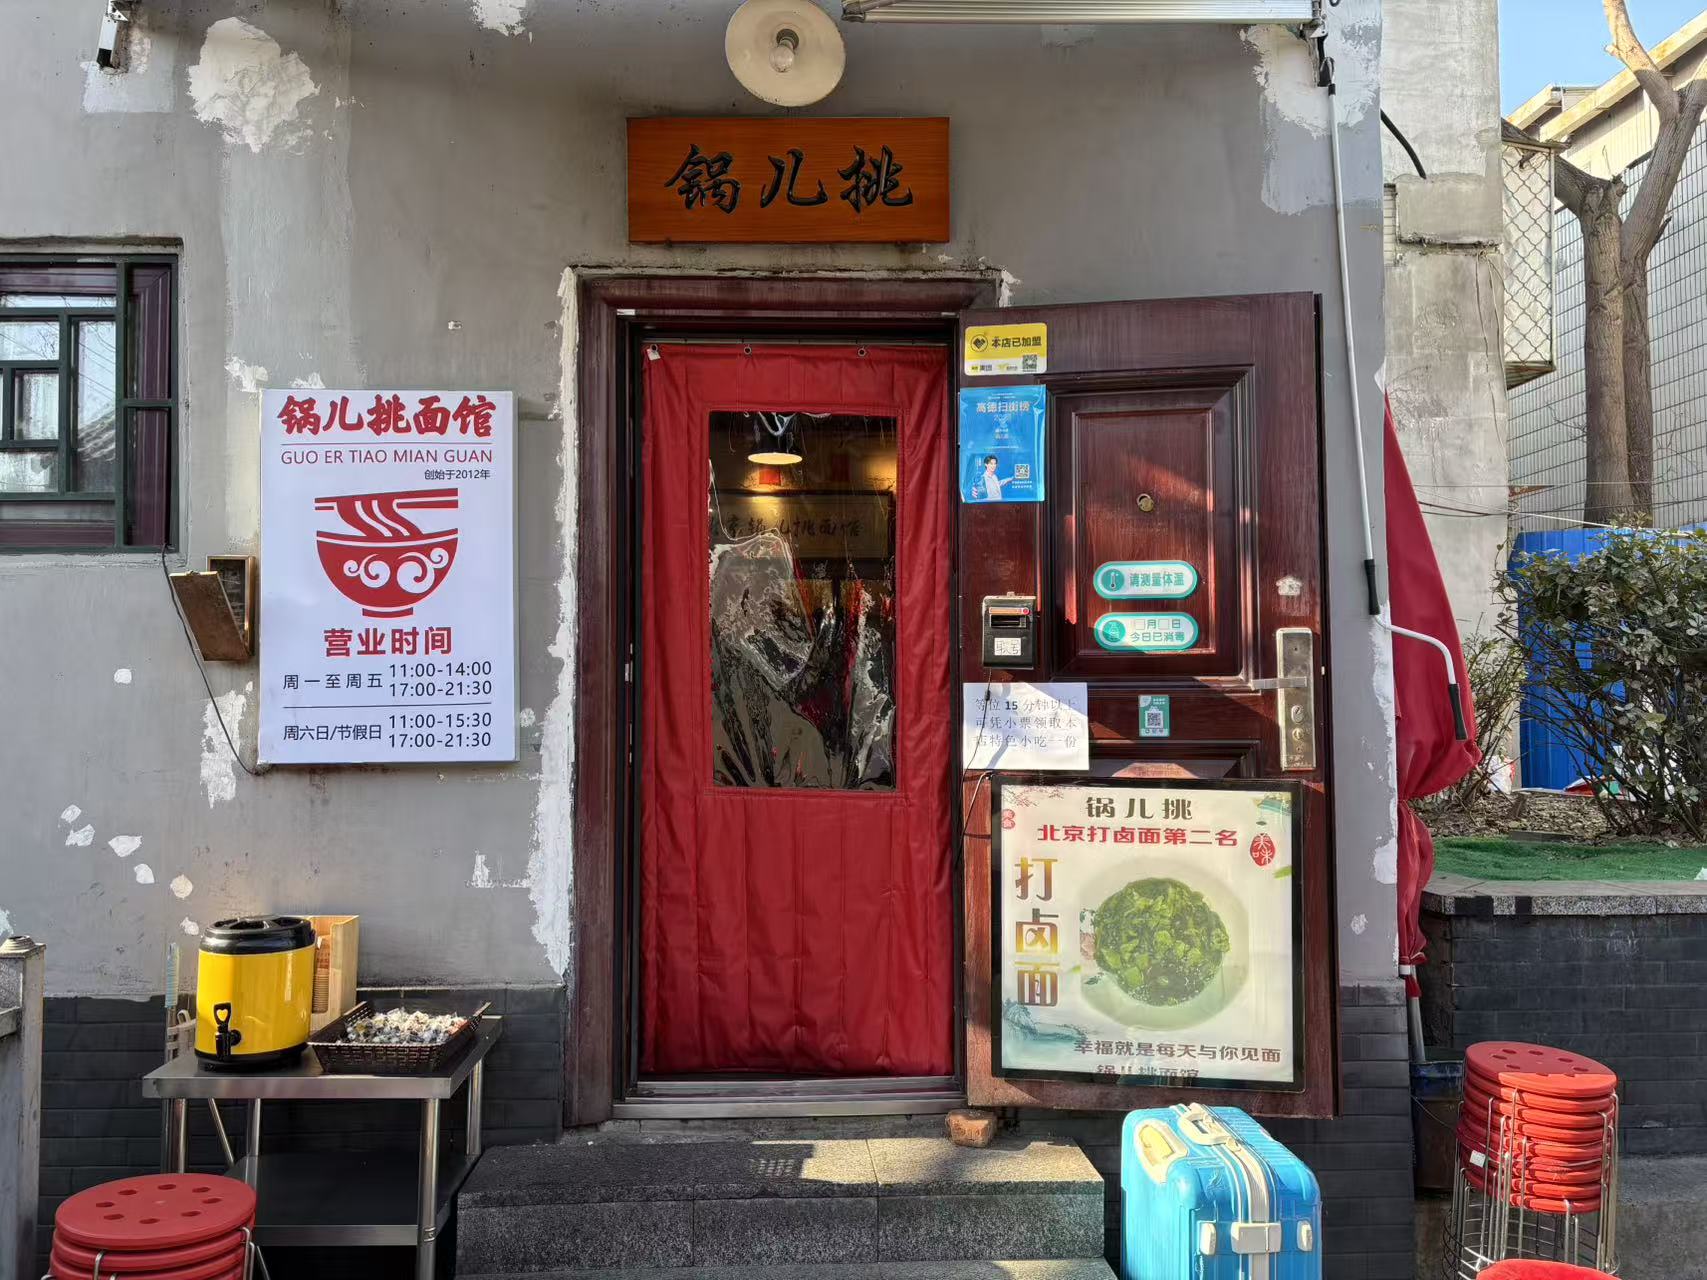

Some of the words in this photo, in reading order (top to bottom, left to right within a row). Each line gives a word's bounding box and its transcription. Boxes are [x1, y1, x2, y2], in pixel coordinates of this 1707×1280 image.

[664, 144, 914, 214] 锅儿挑
[992, 336, 1042, 348] 本店已加盟
[277, 394, 497, 438] 锅儿挑面馆
[281, 450, 319, 465] GUO
[325, 450, 344, 464] ER
[349, 450, 388, 464] TIAO
[394, 450, 438, 464] MIAN
[444, 450, 493, 464] GUAN
[424, 469, 490, 480] 创始于2012年
[1130, 573, 1184, 587] 请测量体温
[324, 626, 451, 657] 营业时间
[1130, 632, 1185, 642] 今日已消毒
[390, 661, 492, 677] 11:00-14:00
[283, 673, 384, 690] 周一至周五
[390, 680, 492, 696] 17:00-21:30
[389, 712, 492, 728] 11:00-15:30
[283, 723, 382, 741] 周六日/节假日
[389, 732, 492, 748] 17:00-21:30
[1086, 797, 1192, 820] 锅儿挑
[1037, 824, 1238, 846] 北京打卤面第二名
[1014, 857, 1059, 1007] 打卤面
[1074, 1040, 1282, 1064] 幸福就是每天与你见面
